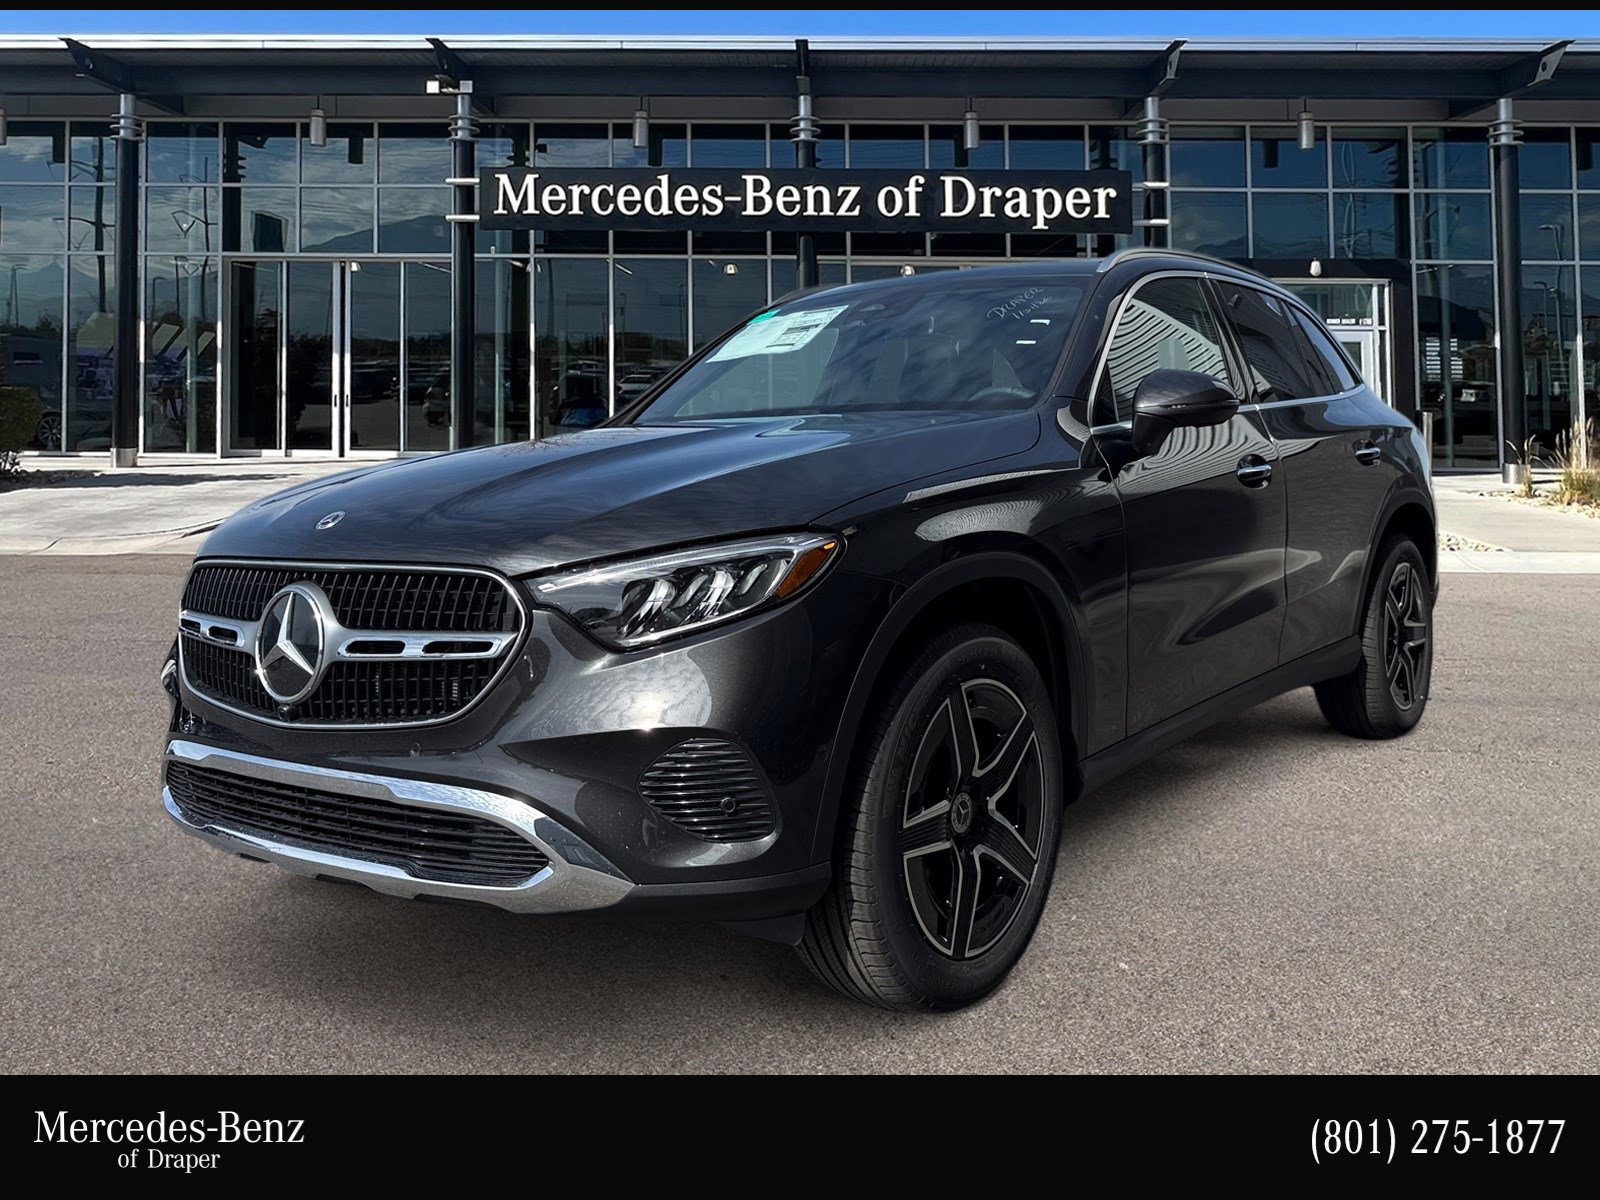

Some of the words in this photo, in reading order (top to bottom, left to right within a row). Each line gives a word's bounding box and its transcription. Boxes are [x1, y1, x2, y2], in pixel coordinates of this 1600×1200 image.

[493, 173, 861, 217] Mercedes-Benz
[877, 174, 926, 217] of
[939, 175, 1117, 230] Draper
